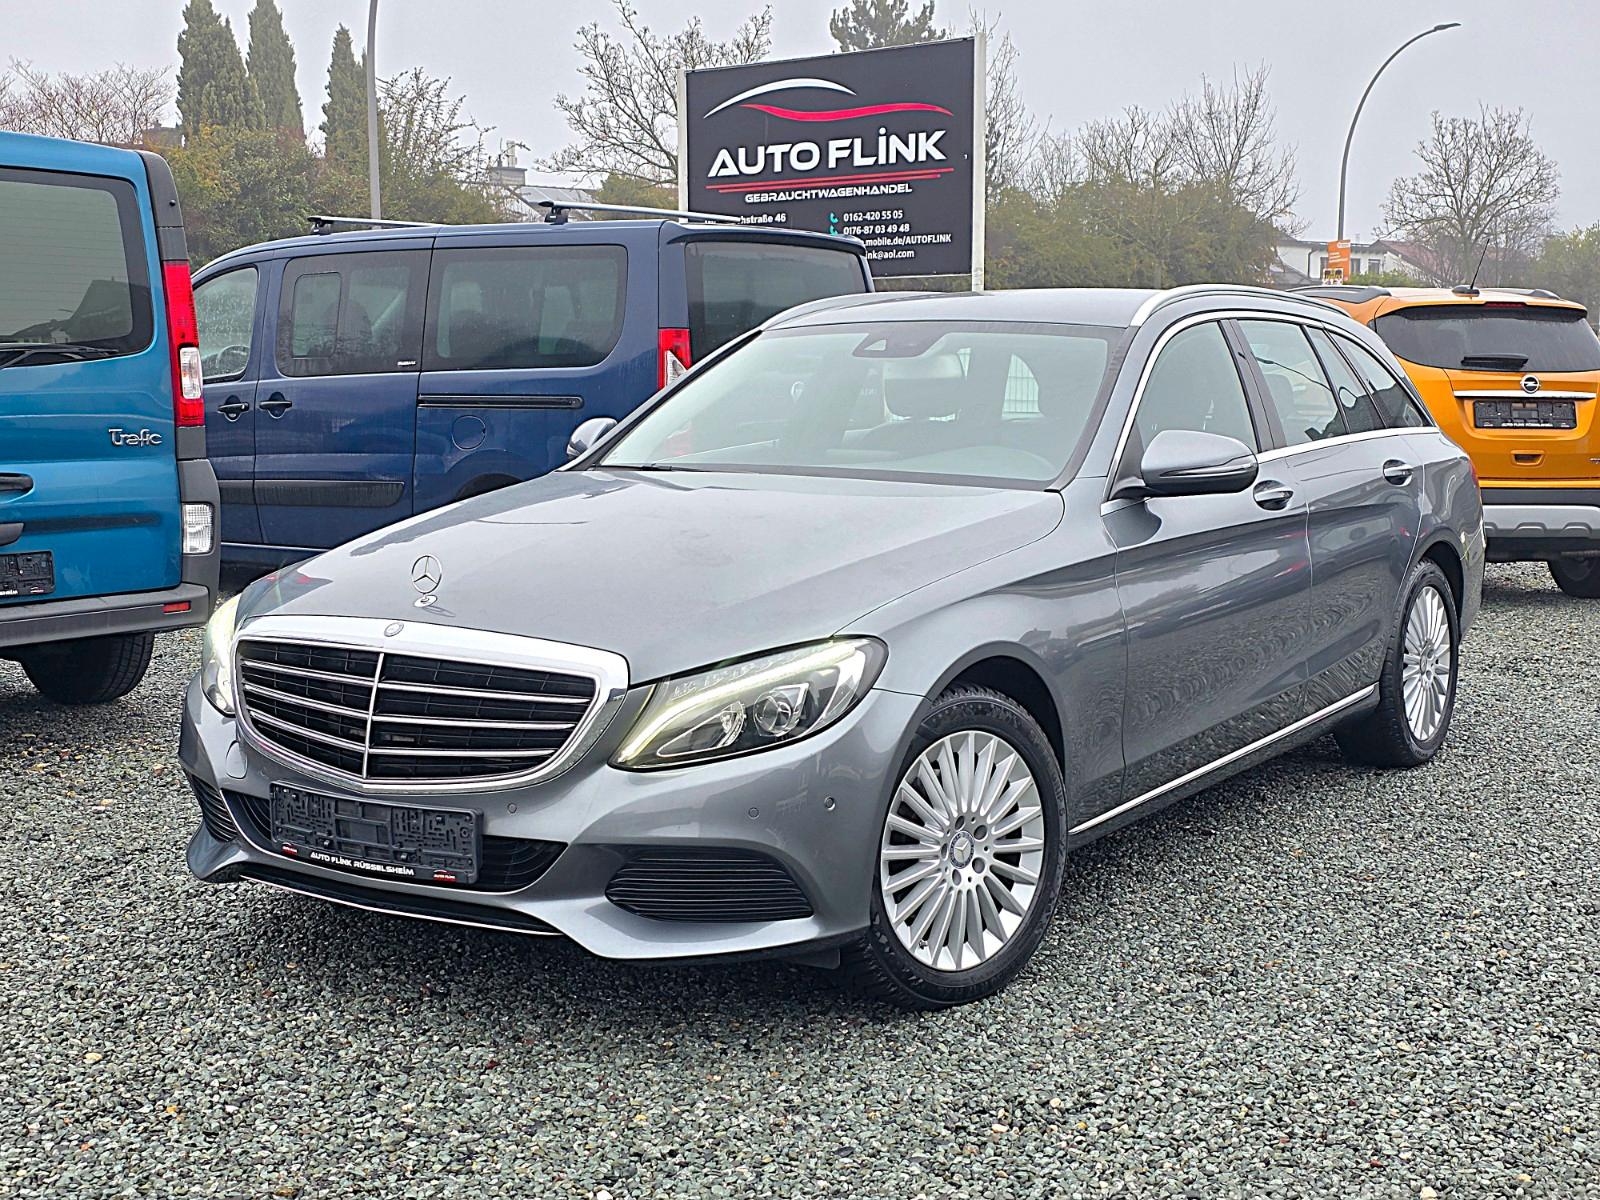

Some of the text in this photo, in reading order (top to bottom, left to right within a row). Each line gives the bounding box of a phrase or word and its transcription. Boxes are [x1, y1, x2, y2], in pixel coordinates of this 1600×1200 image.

[707, 141, 820, 177] AUTO
[745, 183, 912, 204] GEBRAUCHTWAGENHANDEL
[774, 212, 786, 222] 46
[843, 210, 903, 222] 0162-420 55 05
[843, 223, 910, 235] 0176-87 03 49 48
[108, 428, 163, 447] Trafic
[310, 851, 330, 862] AUTO
